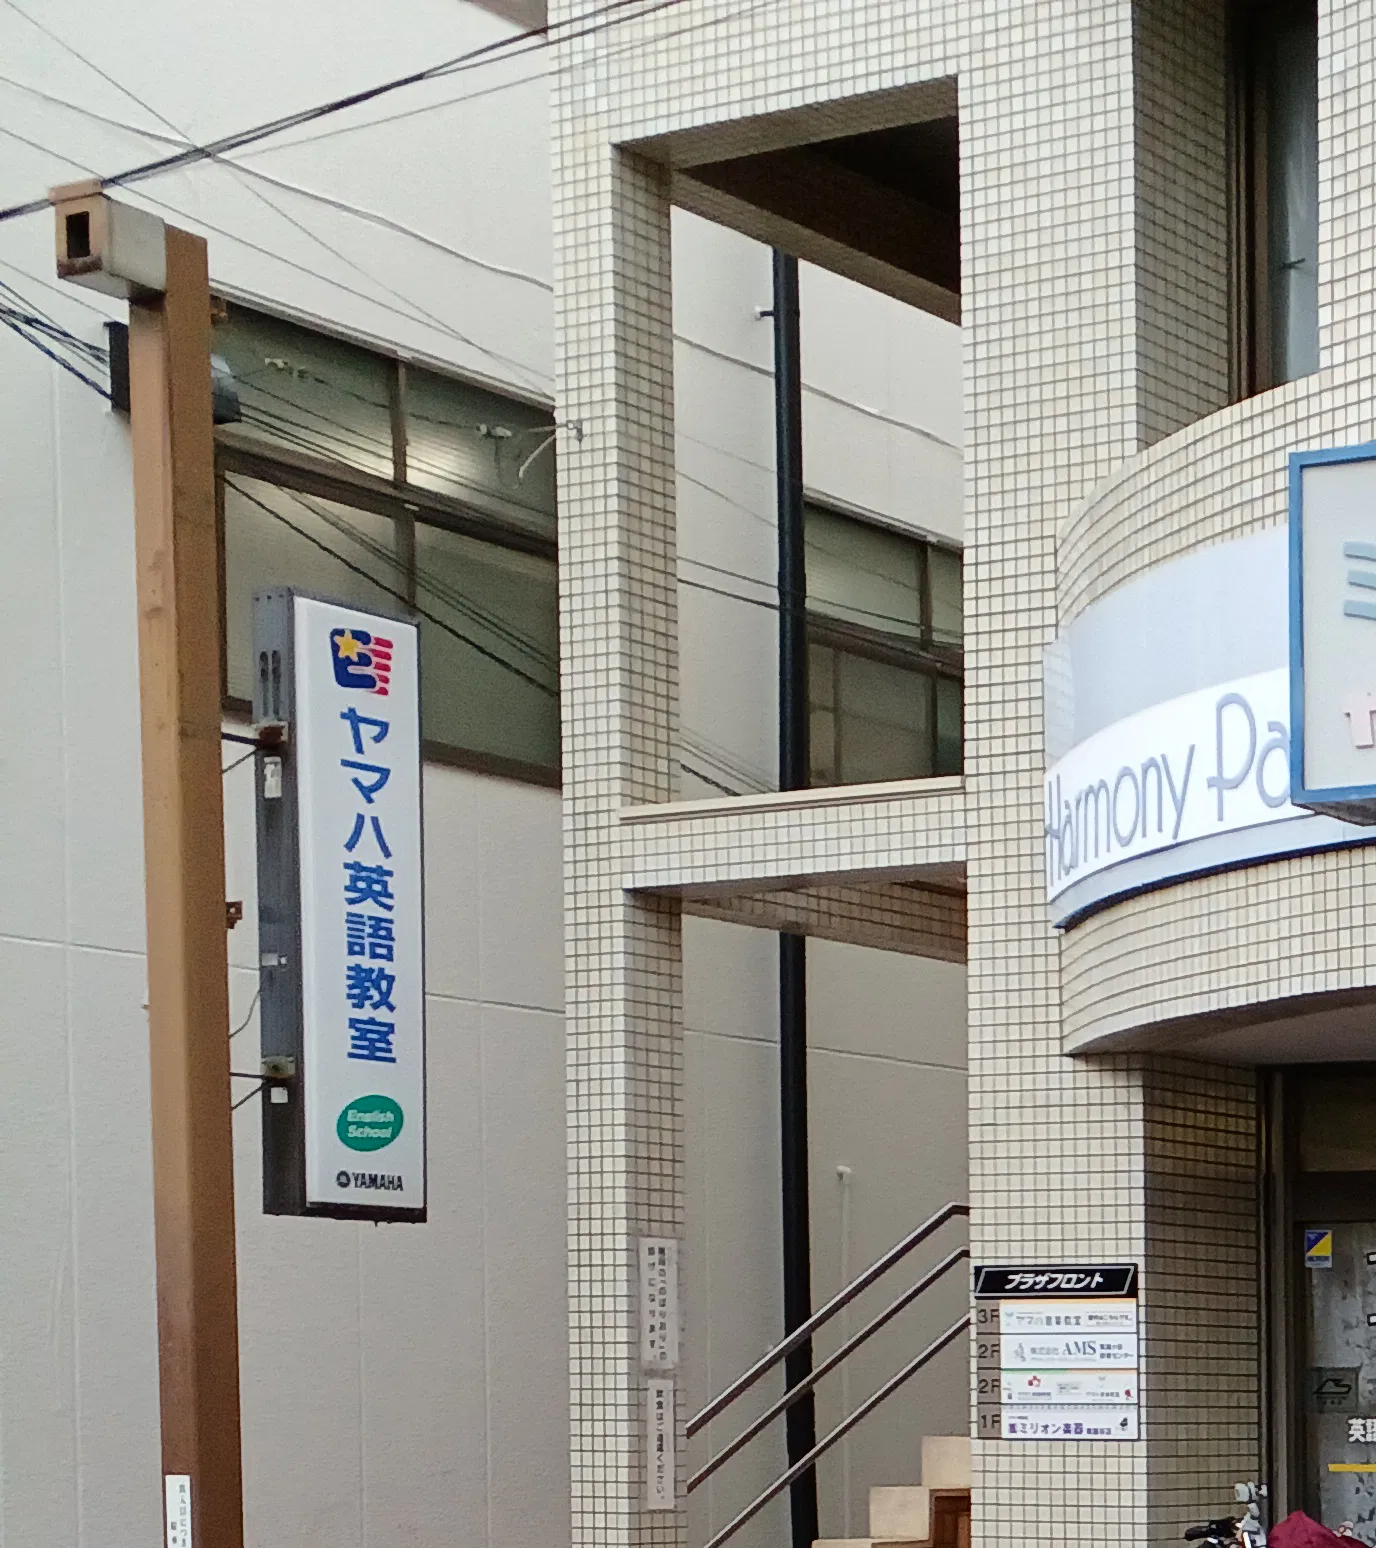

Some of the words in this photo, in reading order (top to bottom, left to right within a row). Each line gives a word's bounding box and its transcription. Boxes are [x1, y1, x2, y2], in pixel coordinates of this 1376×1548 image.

[1045, 744, 1196, 887] Harmony
[339, 706, 398, 1064] ヤマハ英語教室
[351, 1172, 404, 1191] YAMAHA
[1004, 1272, 1104, 1290] プラザフロント
